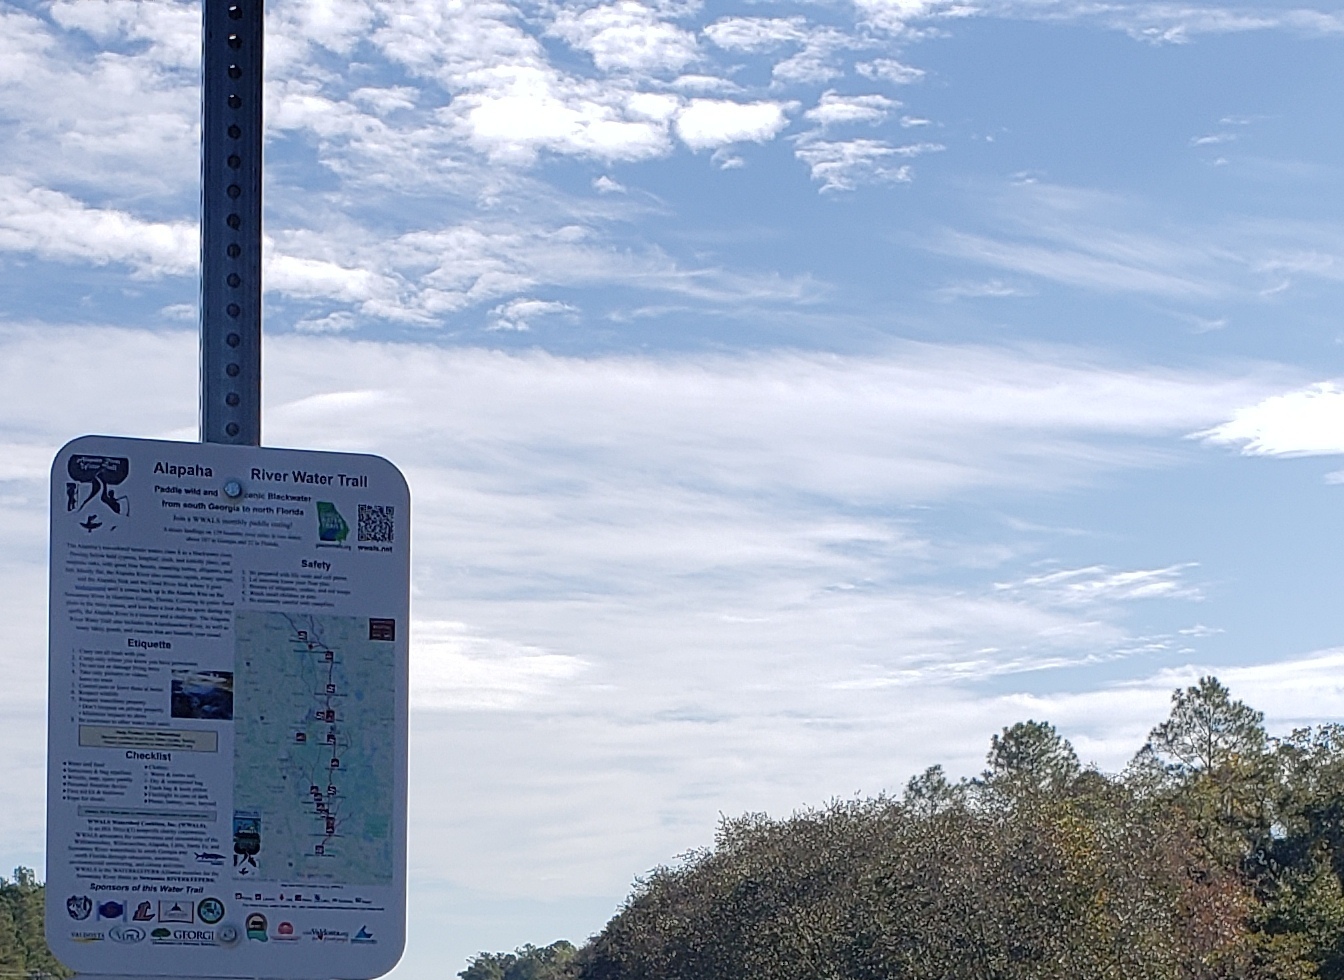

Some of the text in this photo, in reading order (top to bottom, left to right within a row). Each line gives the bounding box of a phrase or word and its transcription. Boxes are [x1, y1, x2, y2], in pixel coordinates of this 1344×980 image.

[154, 462, 368, 488] Alapaha River Water Trail
[154, 485, 312, 502] Paddle wild and cenic Blackwater
[162, 499, 181, 508] from
[183, 501, 206, 509] south
[208, 503, 240, 513] Georgia
[242, 504, 250, 512] to
[276, 507, 304, 515] Florida
[301, 559, 332, 571] Safety
[127, 638, 172, 650] Etiquette
[125, 751, 172, 762] Checklist
[90, 883, 130, 892] Sponsors
[174, 930, 215, 940] GEORGI
